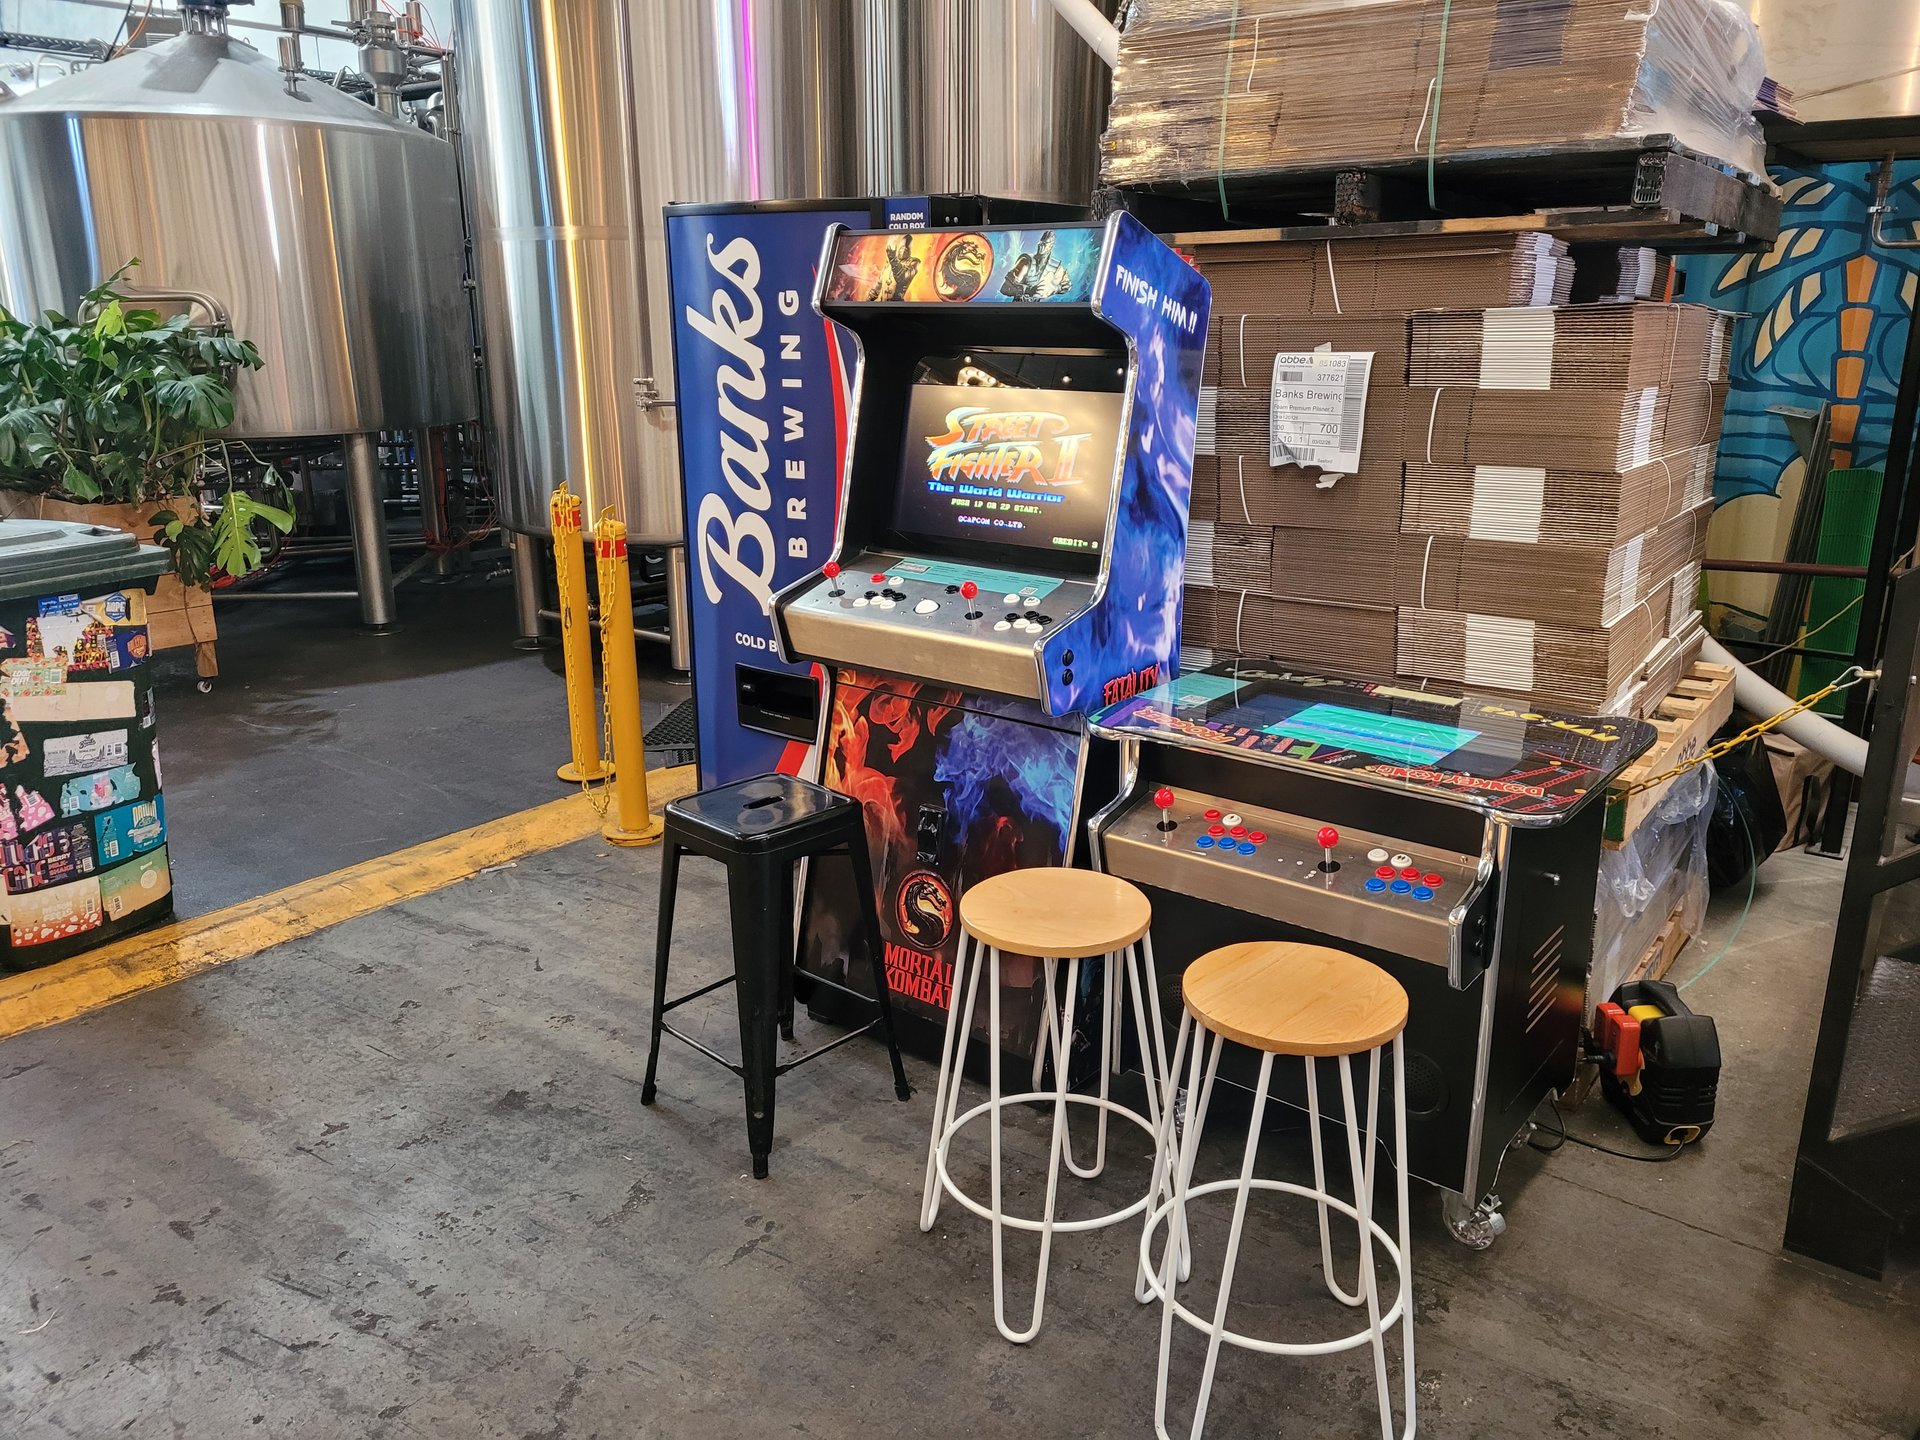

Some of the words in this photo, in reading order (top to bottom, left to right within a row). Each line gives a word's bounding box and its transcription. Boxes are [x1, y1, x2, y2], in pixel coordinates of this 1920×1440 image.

[890, 212, 924, 221] RANDOM
[1116, 264, 1159, 310] FINISH
[1280, 356, 1307, 364] abbe
[1317, 373, 1344, 382] 377621
[1275, 388, 1304, 399] Banks
[1306, 389, 1343, 403] Brewing
[686, 233, 776, 616] Banks
[778, 289, 808, 559] BREWING
[924, 406, 1070, 447] STREET
[1320, 423, 1338, 434] 700
[926, 440, 1048, 486] FIGHTER
[928, 480, 955, 494] The
[958, 484, 1003, 498] World
[1006, 488, 1065, 504] Warrior
[951, 498, 970, 507] PUSH
[974, 500, 984, 508] 1P
[986, 501, 997, 509] OR
[1000, 503, 1011, 511] 2P
[735, 632, 766, 650] COLD
[1103, 662, 1160, 706] FATALITY
[1133, 707, 1237, 744] FROGGER
[1376, 764, 1443, 783] KONG
[1448, 774, 1545, 798] DONKEY
[47, 852, 71, 863] BERRY
[885, 964, 953, 1011] KOMBAT
